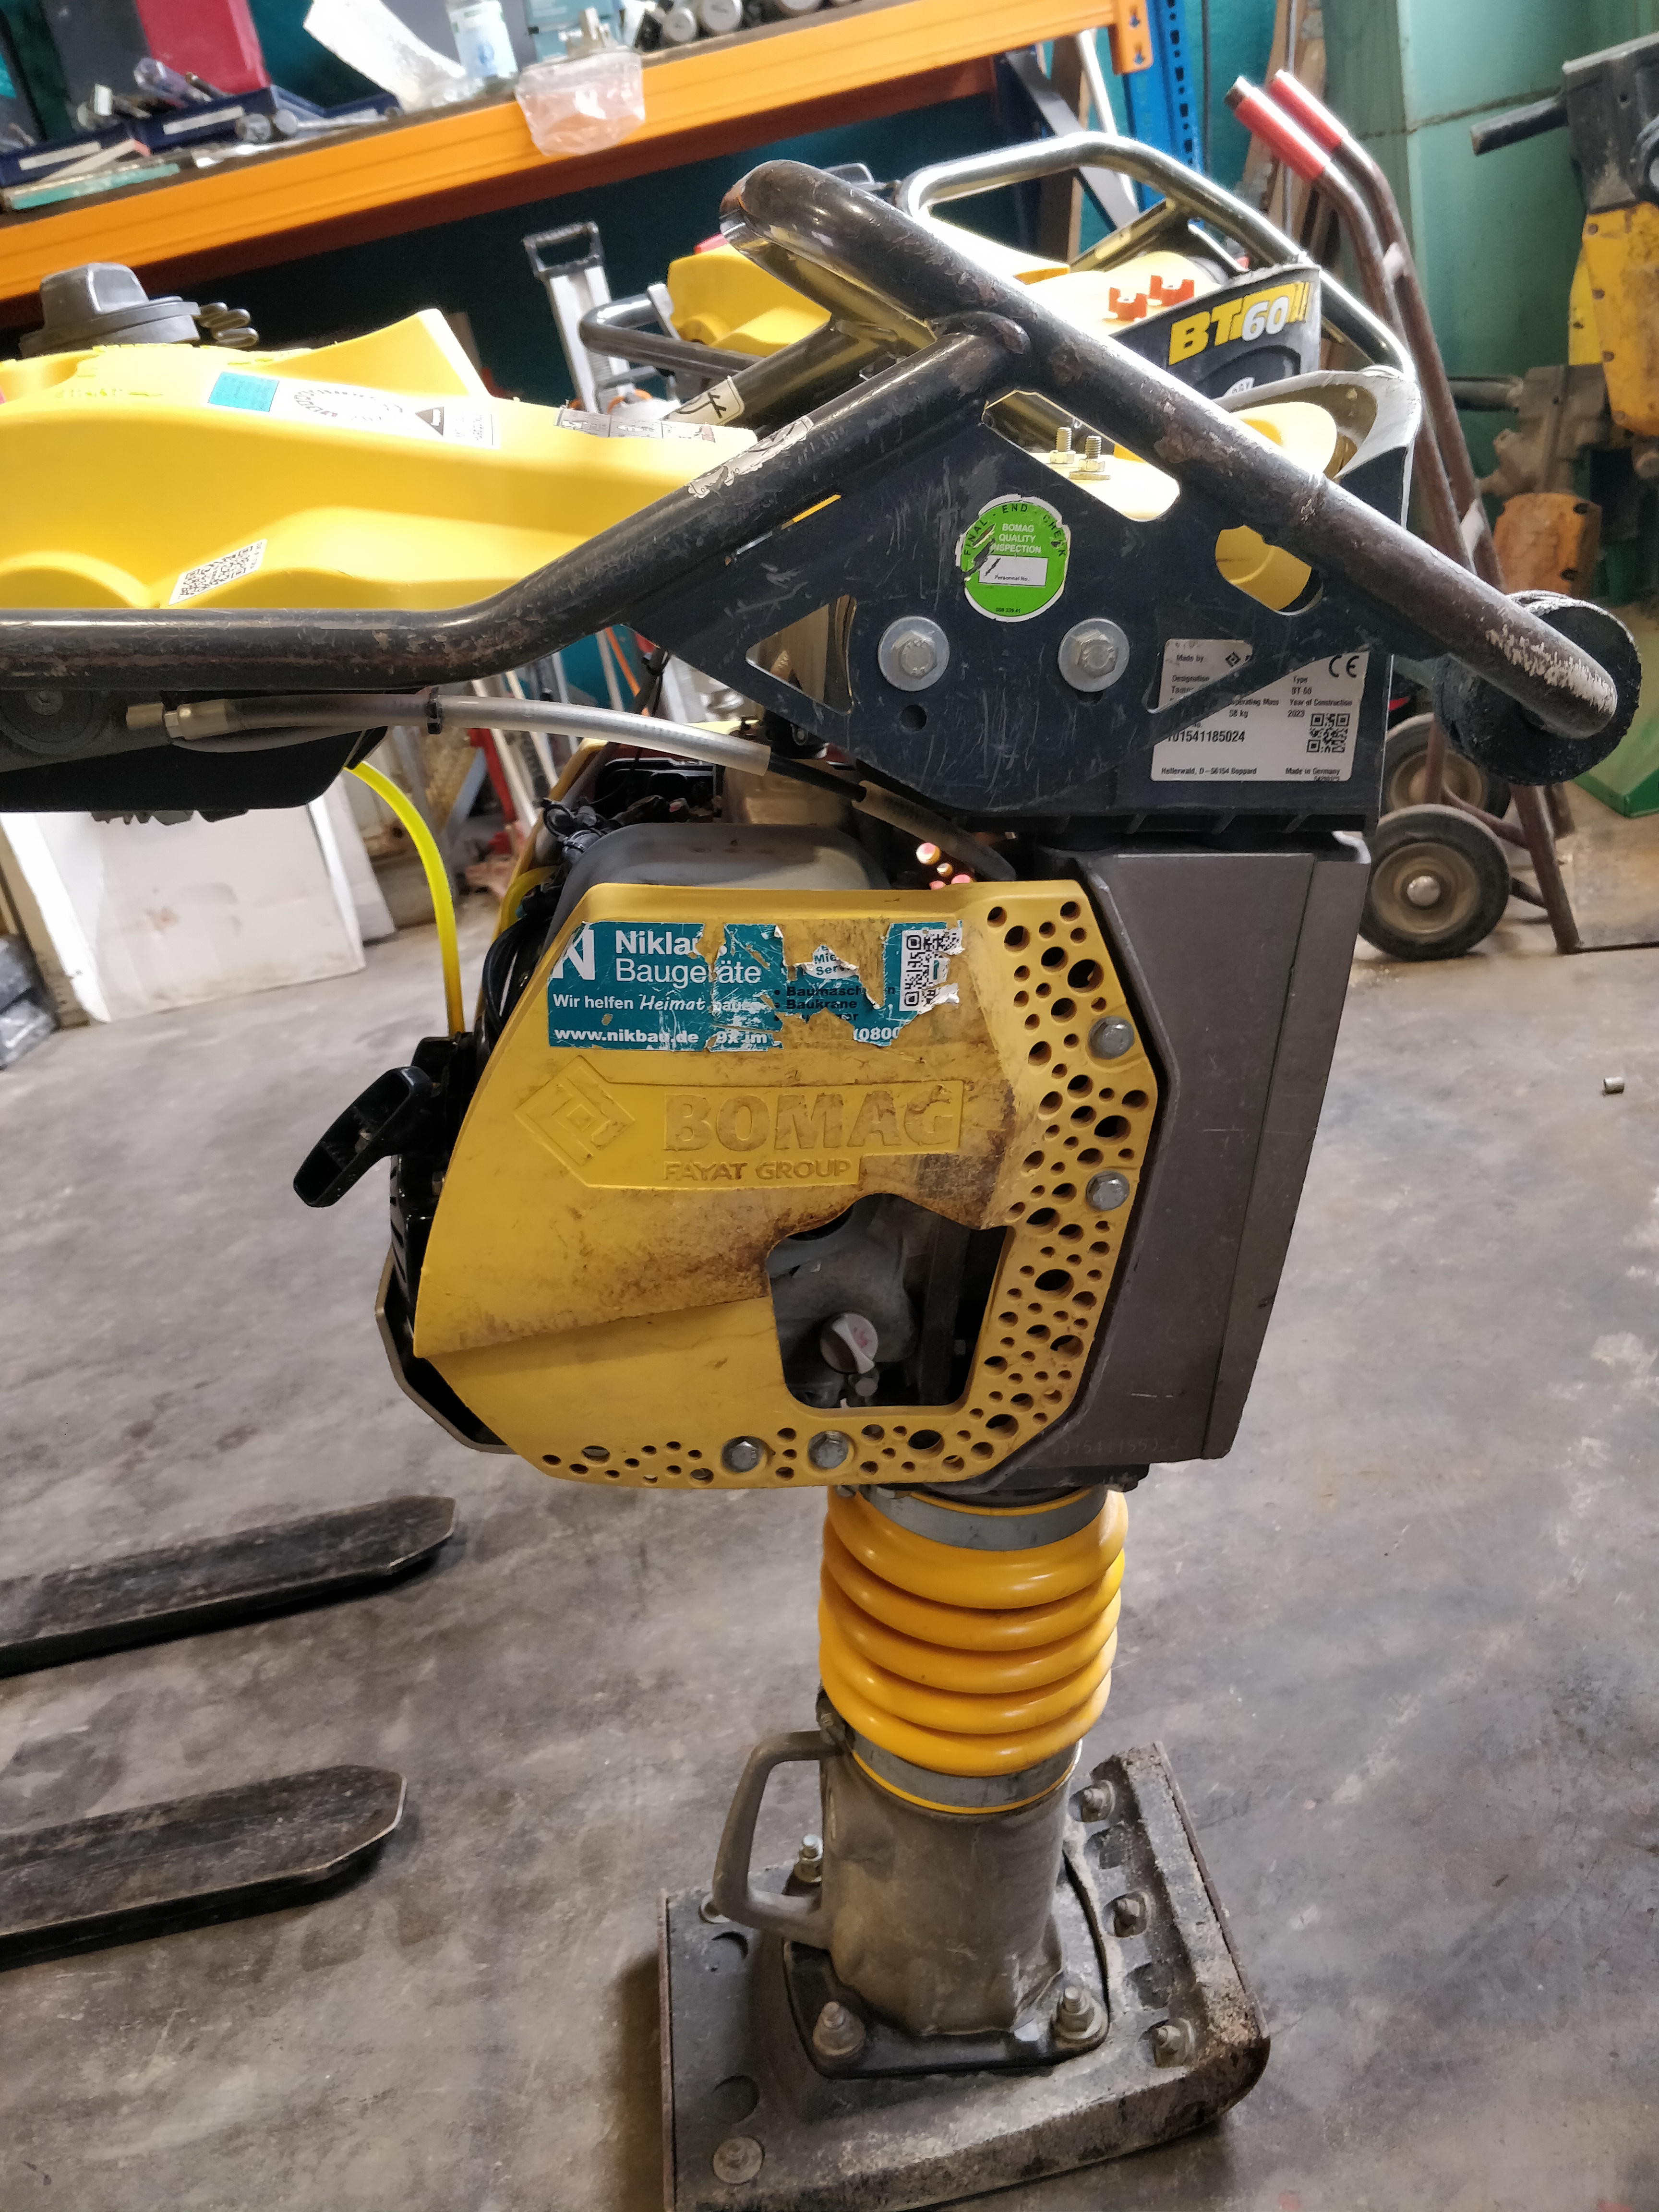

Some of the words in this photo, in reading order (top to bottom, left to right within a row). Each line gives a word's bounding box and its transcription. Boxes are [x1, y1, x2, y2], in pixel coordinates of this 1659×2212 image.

[963, 519, 988, 556] FINAL
[1002, 504, 1028, 513] END
[1043, 514, 1066, 557] CHEK
[1002, 523, 1034, 532] BOMAG
[999, 533, 1036, 542] QUALITY
[991, 543, 1042, 553] INSPECTION
[1176, 654, 1194, 662] Made
[1196, 654, 1204, 663] by
[1171, 674, 1210, 683] Designation
[1305, 698, 1313, 706] of
[1313, 698, 1353, 707] Construction
[1240, 709, 1249, 719] kg
[1287, 709, 1305, 718] 2023
[1312, 767, 1342, 776] Germany
[553, 993, 579, 1008] Wir
[584, 995, 634, 1009] helfen
[638, 994, 706, 1010] Heimat
[553, 1029, 699, 1044] www.nikbau.de
[664, 1090, 954, 1152] BOMAG
[663, 1160, 749, 1181] FAYAT
[755, 1158, 852, 1180] GROUP
